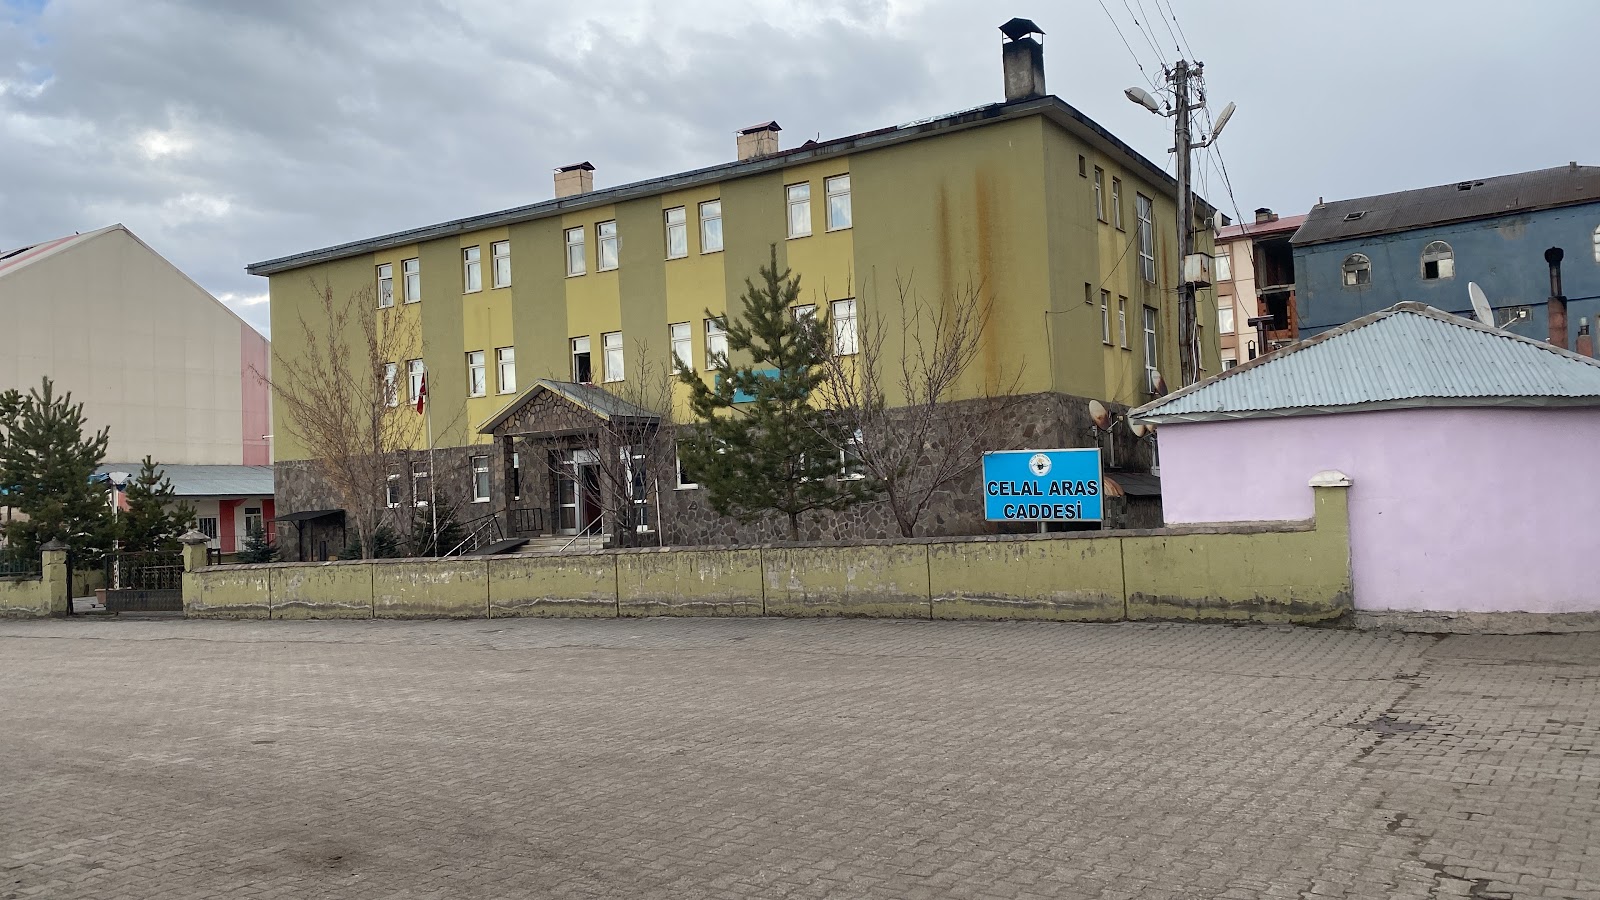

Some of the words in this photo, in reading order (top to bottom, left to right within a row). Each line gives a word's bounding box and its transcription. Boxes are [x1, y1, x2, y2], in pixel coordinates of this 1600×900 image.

[987, 480, 1043, 496] CELAL
[1049, 480, 1098, 496] ARAS
[1004, 501, 1082, 519] CADDESİ
